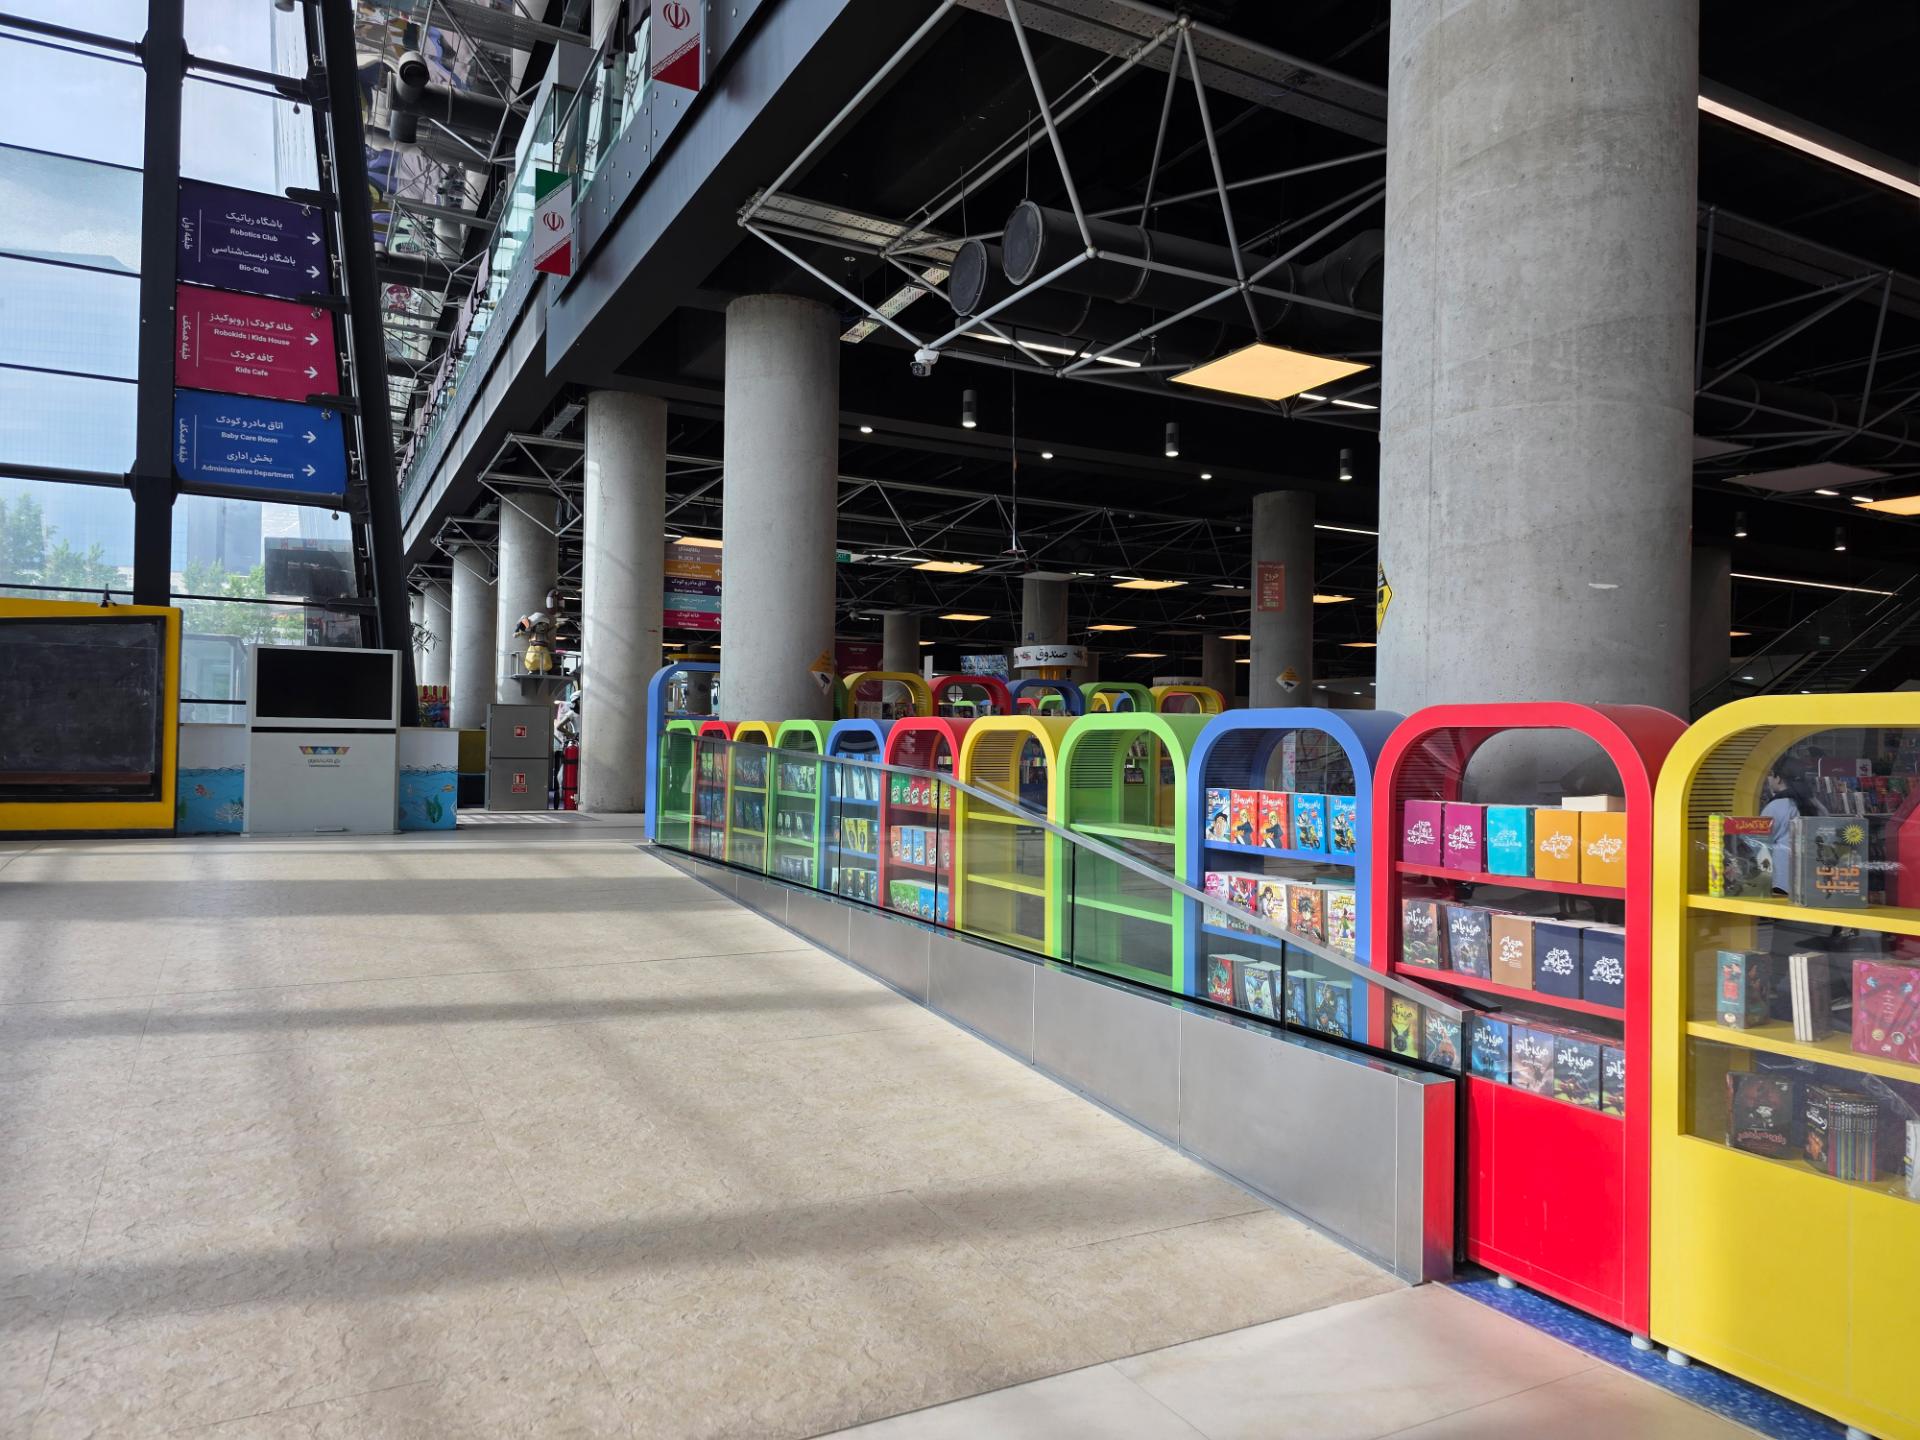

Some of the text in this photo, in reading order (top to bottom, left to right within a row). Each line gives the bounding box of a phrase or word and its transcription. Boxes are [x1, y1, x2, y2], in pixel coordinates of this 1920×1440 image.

[225, 213, 283, 230] باشگاه رباتیک
[230, 228, 278, 242] Robotics Club
[269, 254, 296, 266] باشگاه
[239, 264, 270, 274] Bio-Club
[250, 319, 274, 330] کودک
[276, 323, 294, 331] خانه
[214, 328, 290, 346] Robokids Kids House
[230, 351, 274, 362] کافه کودک
[236, 366, 250, 374] Kids
[216, 416, 242, 426] کودک
[248, 420, 266, 428] مادر
[267, 422, 284, 430] اتاق
[221, 431, 278, 444] Baby Care Room
[226, 452, 272, 464] بخش اداری
[202, 464, 294, 480] Administrative Department
[1036, 648, 1068, 662] صندوق
